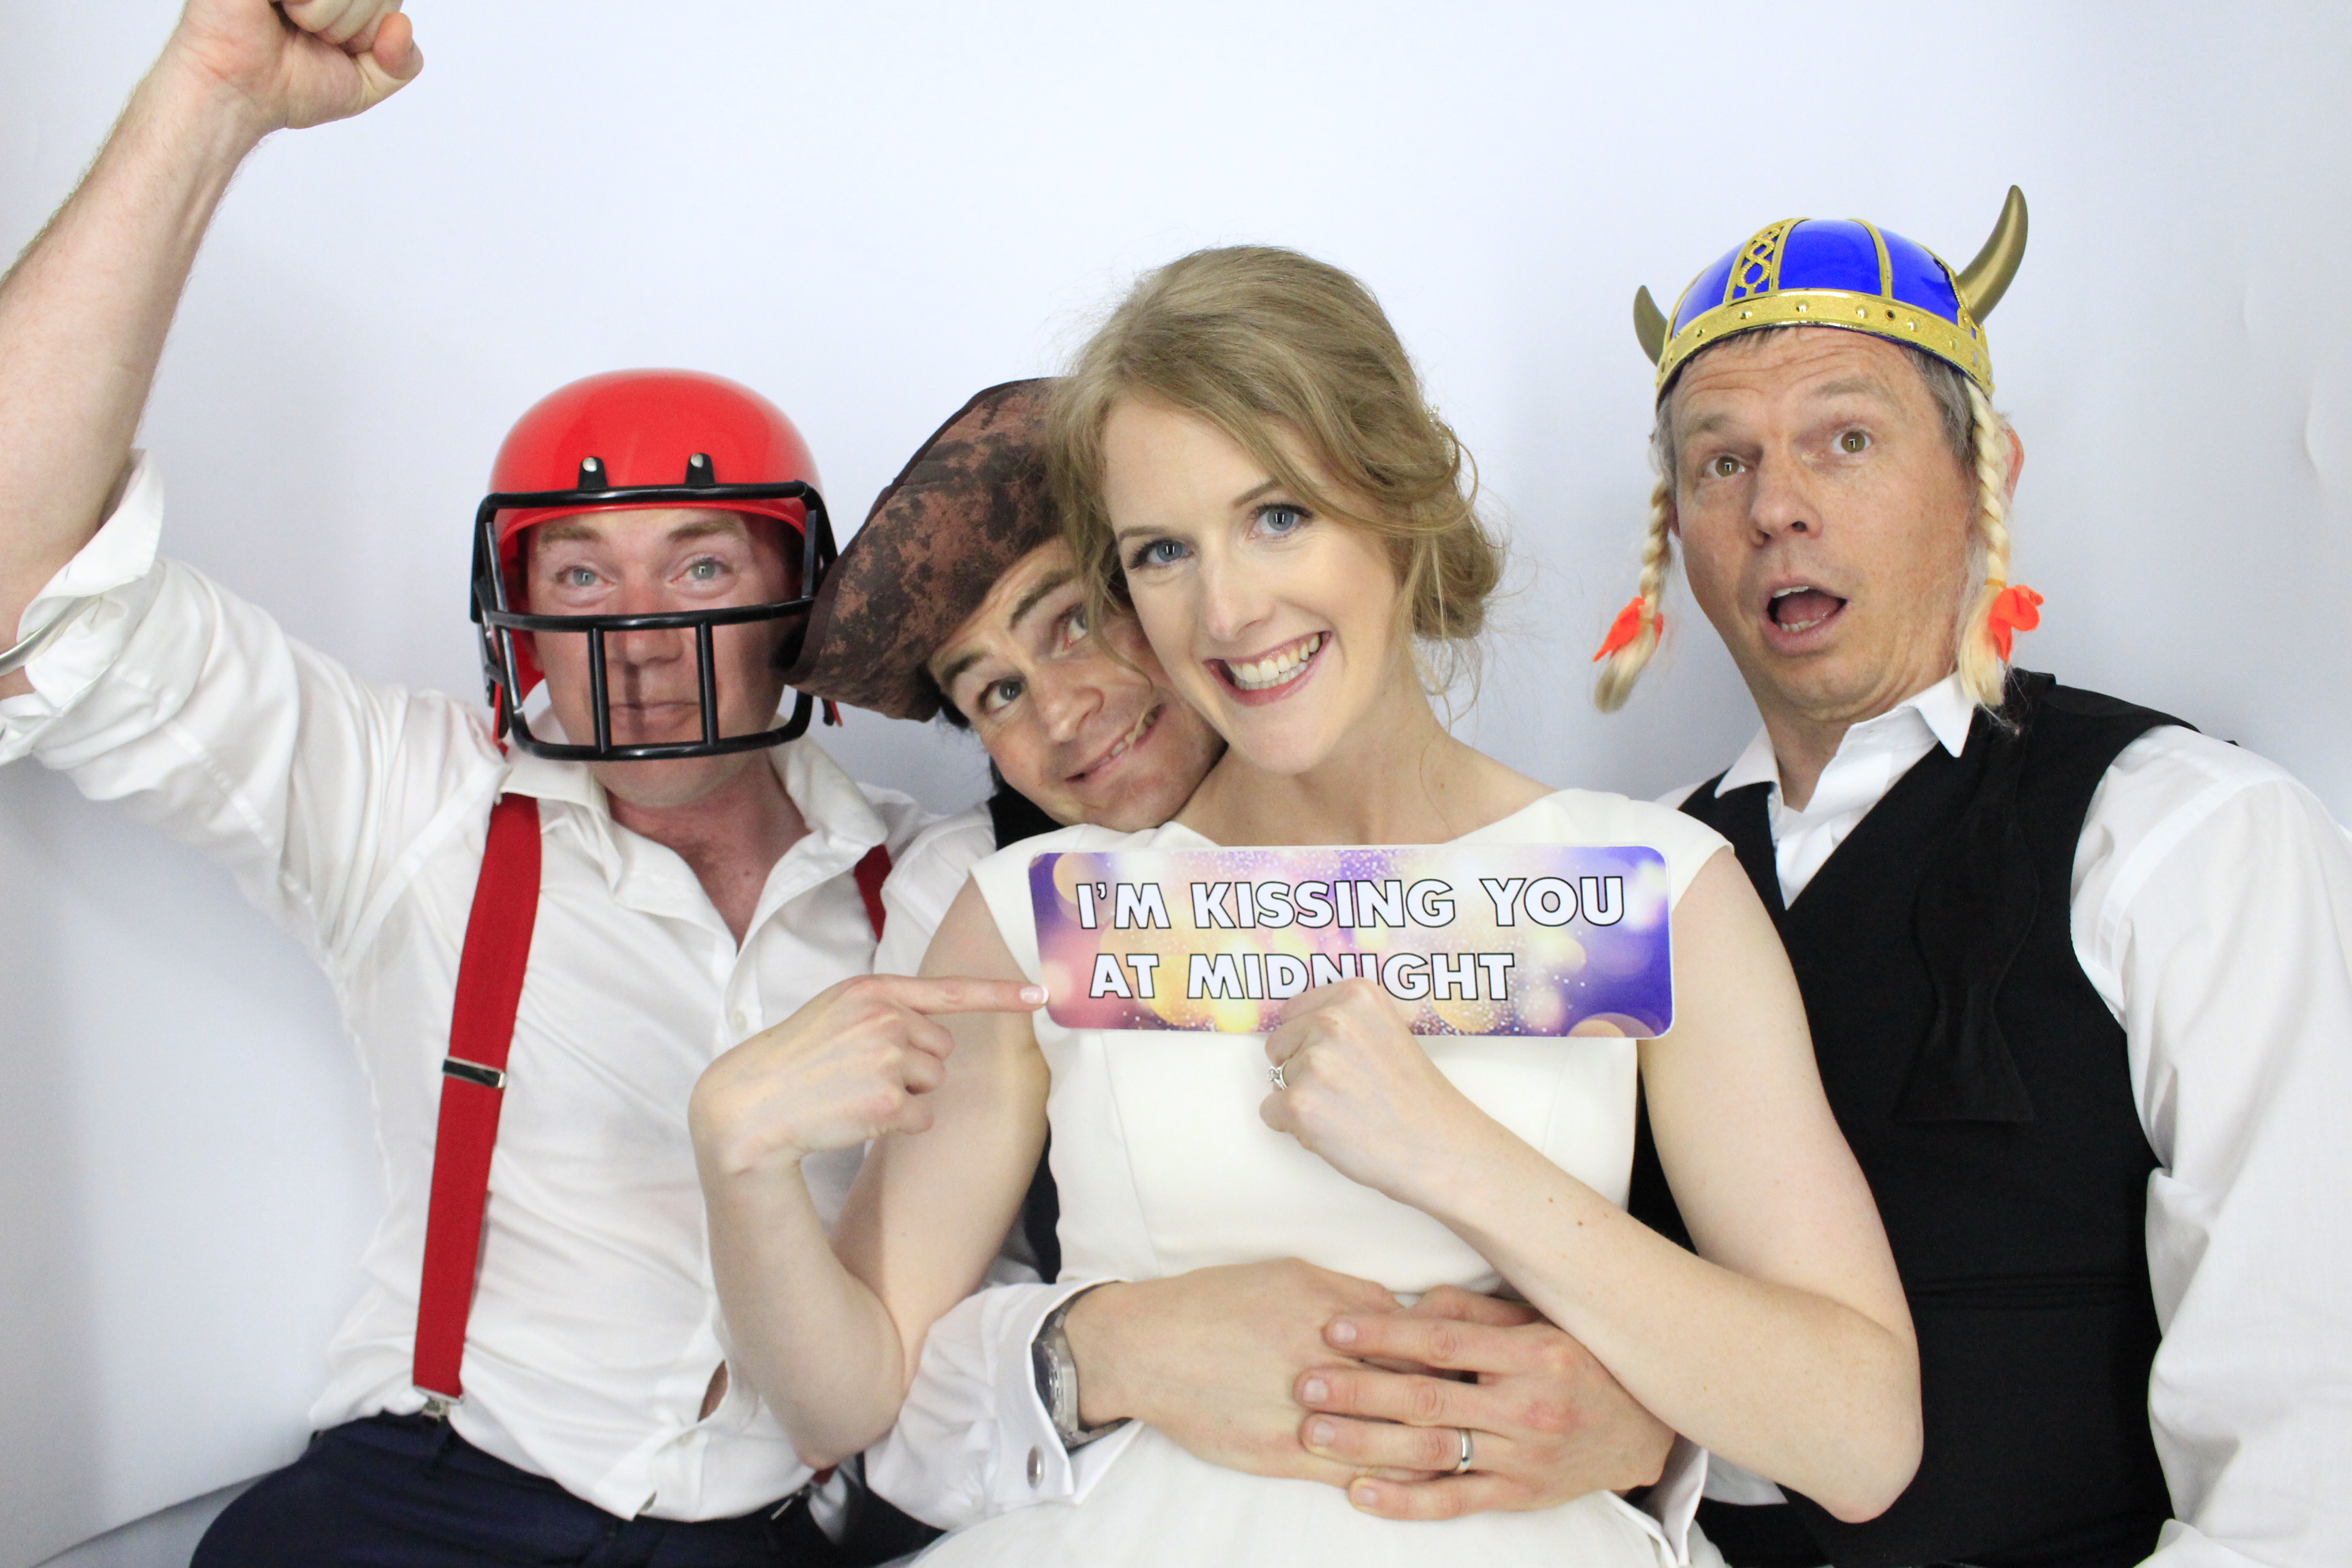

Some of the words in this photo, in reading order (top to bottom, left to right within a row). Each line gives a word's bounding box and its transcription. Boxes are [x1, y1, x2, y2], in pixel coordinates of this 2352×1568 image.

[1075, 882, 1172, 930] I'M
[1190, 879, 1456, 929] KISSING
[1478, 875, 1625, 928] YOU
[1088, 953, 1160, 999] AT
